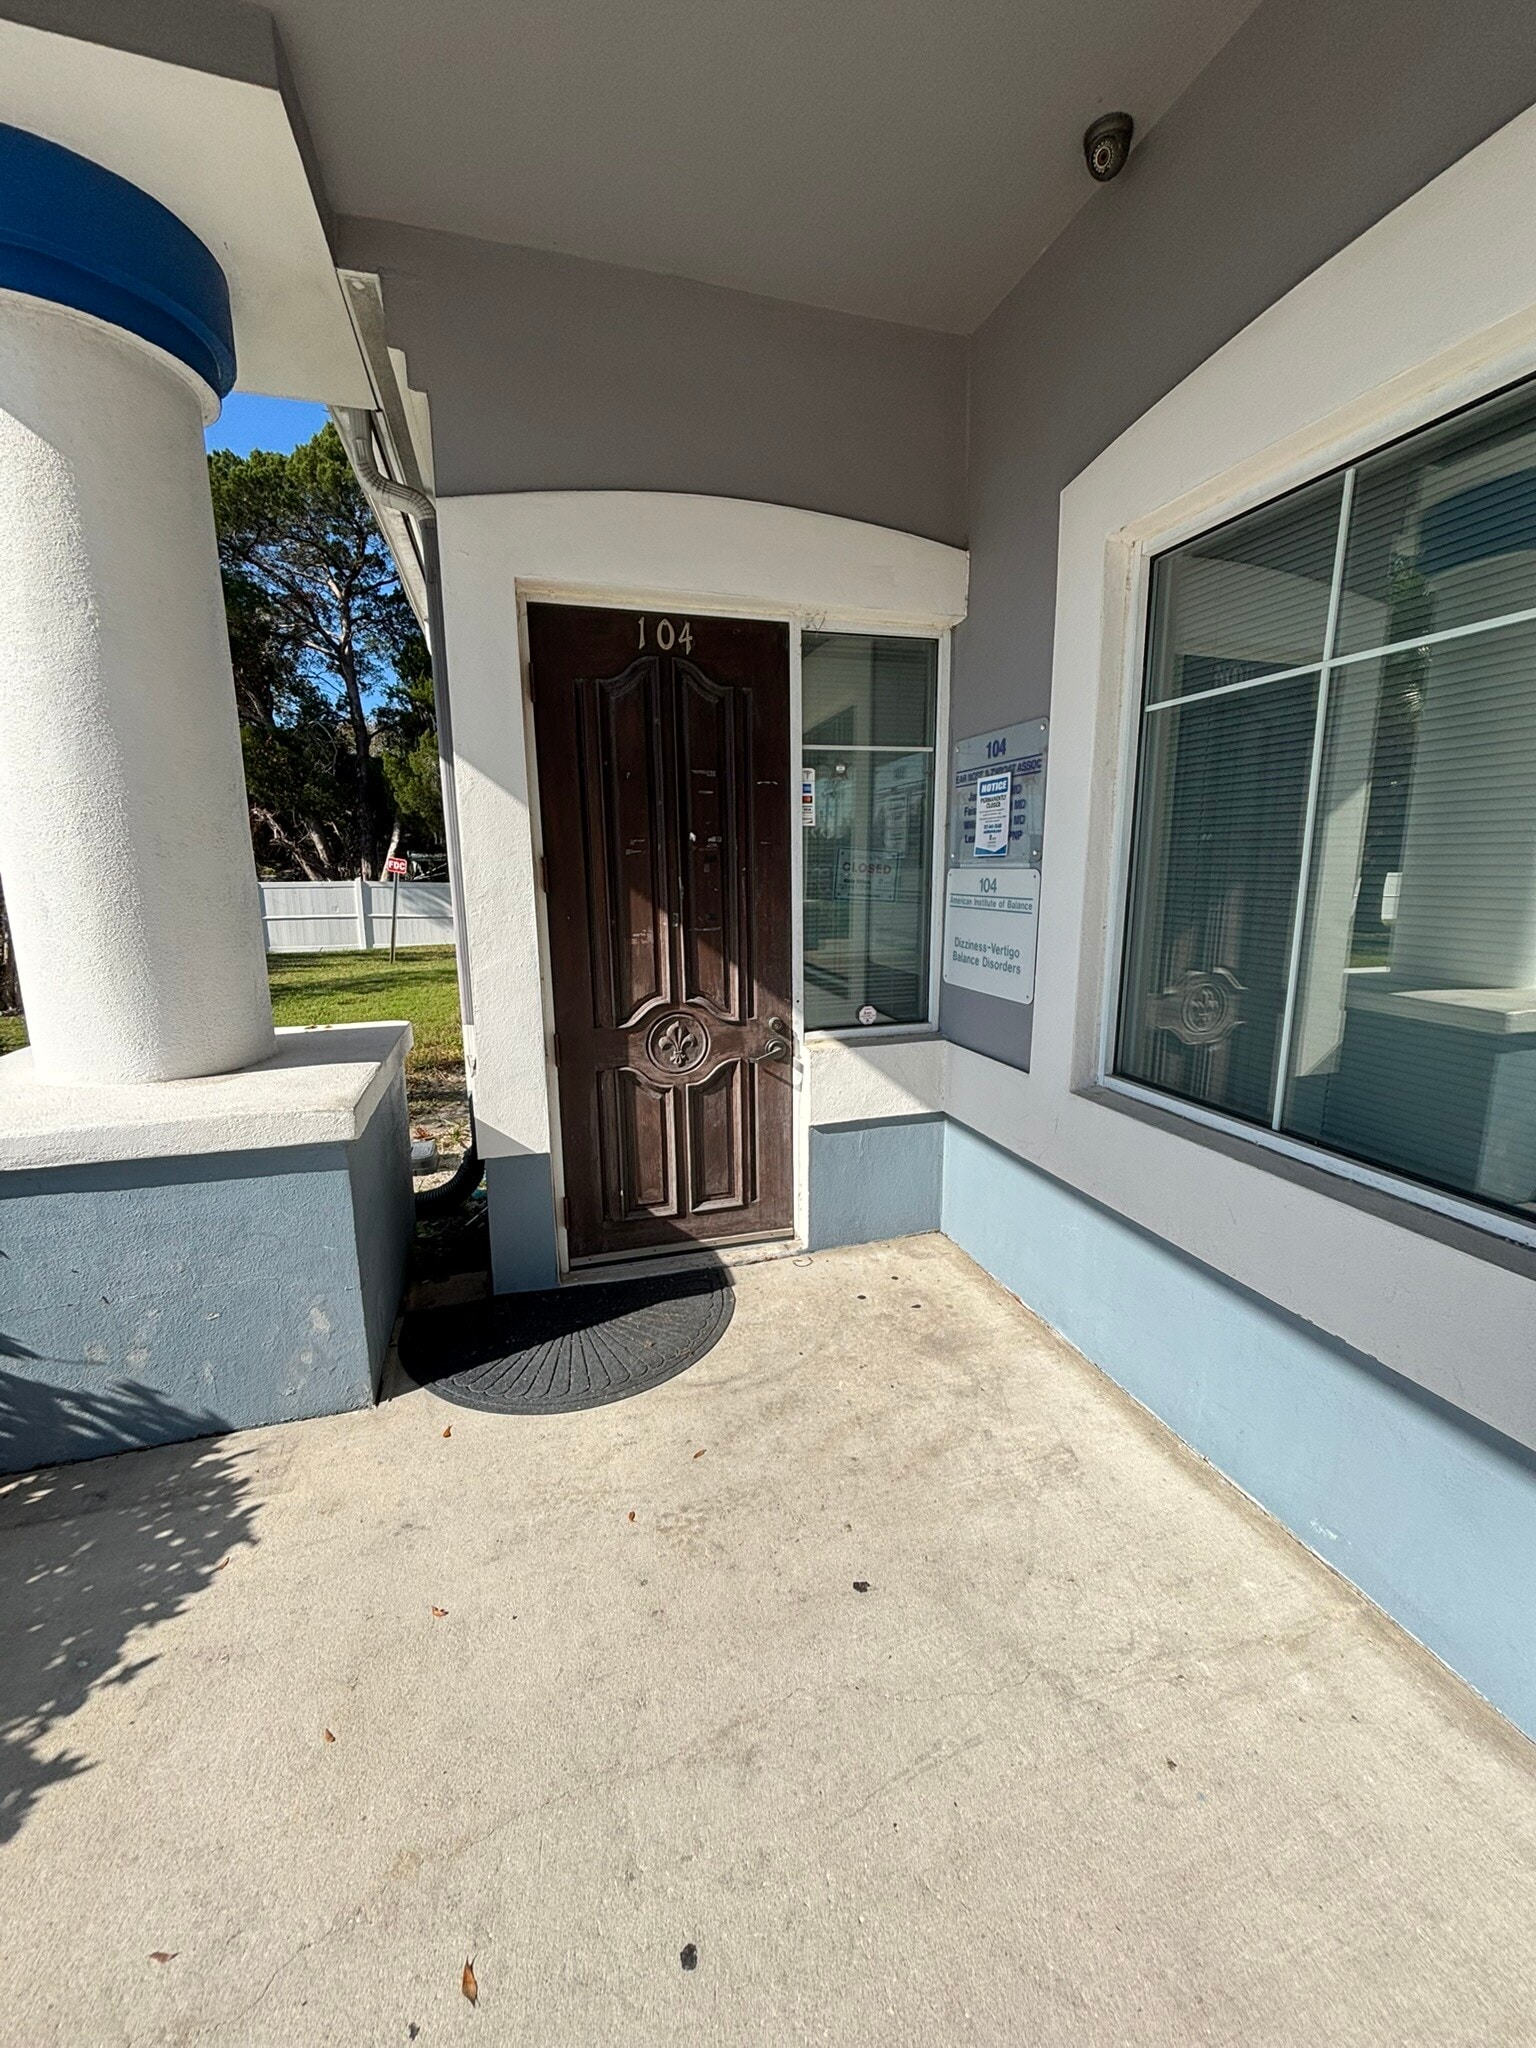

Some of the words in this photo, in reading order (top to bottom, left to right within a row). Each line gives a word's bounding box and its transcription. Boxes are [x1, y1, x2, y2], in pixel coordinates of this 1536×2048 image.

[638, 616, 694, 655] 104
[986, 738, 1007, 759] 104
[956, 774, 968, 784] EAR
[1017, 758, 1042, 772] ASSOC
[981, 780, 1007, 794] NOTICE
[1014, 799, 1026, 810] MD
[1013, 815, 1025, 825] MD
[388, 860, 406, 871] FDC
[842, 861, 892, 874] CLOSED
[979, 878, 997, 893] 104
[950, 896, 972, 906] American
[974, 898, 996, 908] Institute
[998, 899, 1005, 908] of
[1007, 900, 1033, 911] Balance
[954, 937, 1020, 960] Dizziness-Vertigo
[952, 950, 980, 966] Balance
[982, 956, 1021, 975] Disorders
